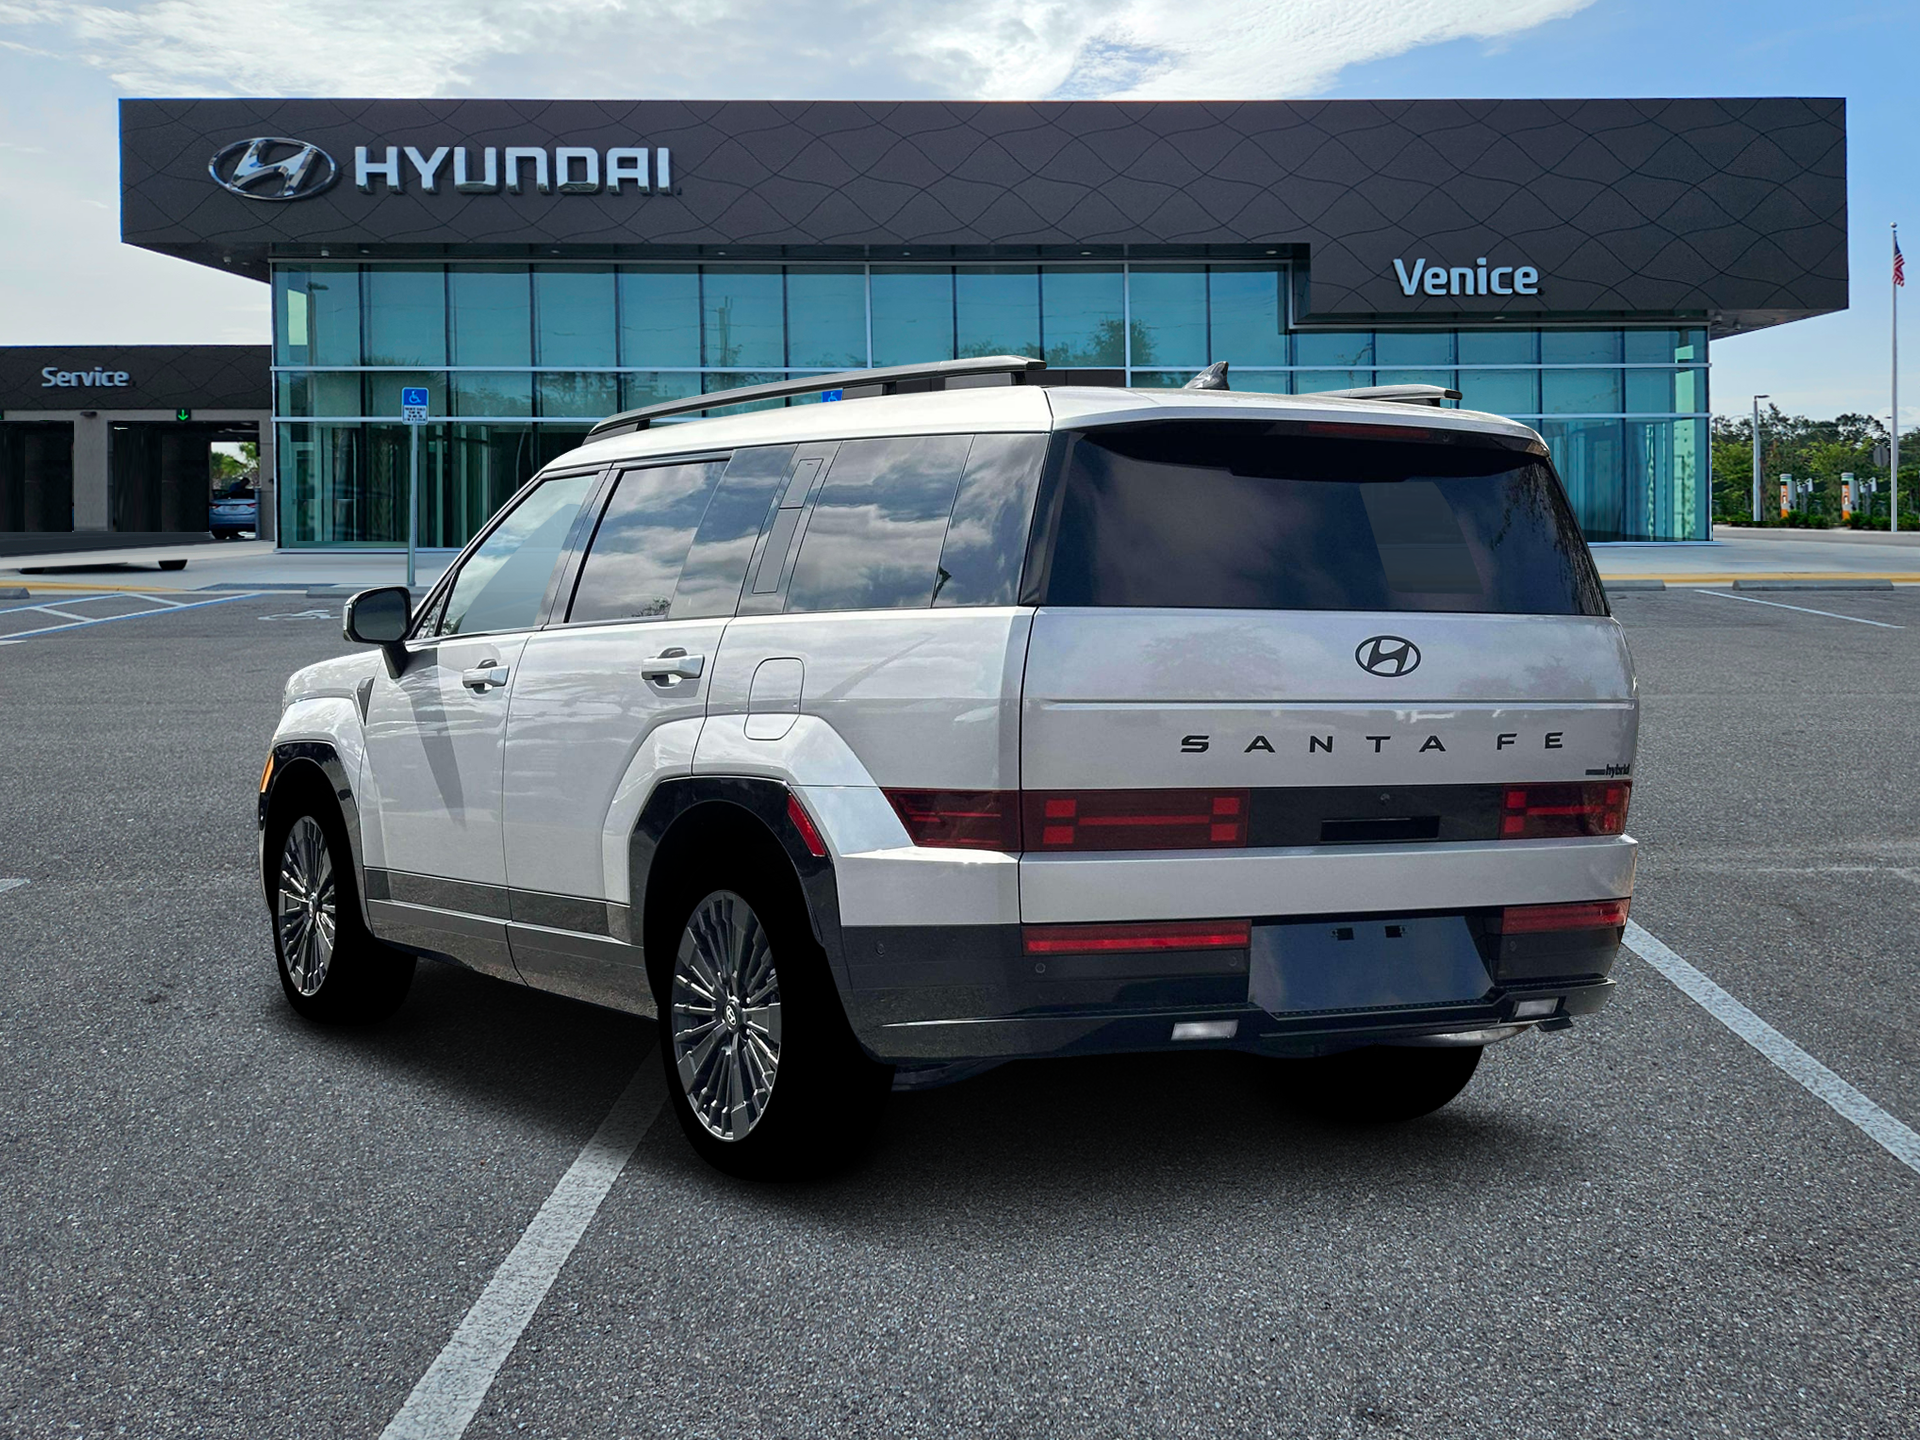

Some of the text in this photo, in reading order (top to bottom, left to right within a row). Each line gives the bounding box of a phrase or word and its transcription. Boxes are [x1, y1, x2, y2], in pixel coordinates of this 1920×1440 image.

[354, 146, 671, 194] HYUNDAI
[1392, 257, 1539, 296] Venice
[41, 366, 130, 387] Service
[1180, 732, 1564, 753] SANTA FE
[1605, 763, 1631, 778] hybrid
